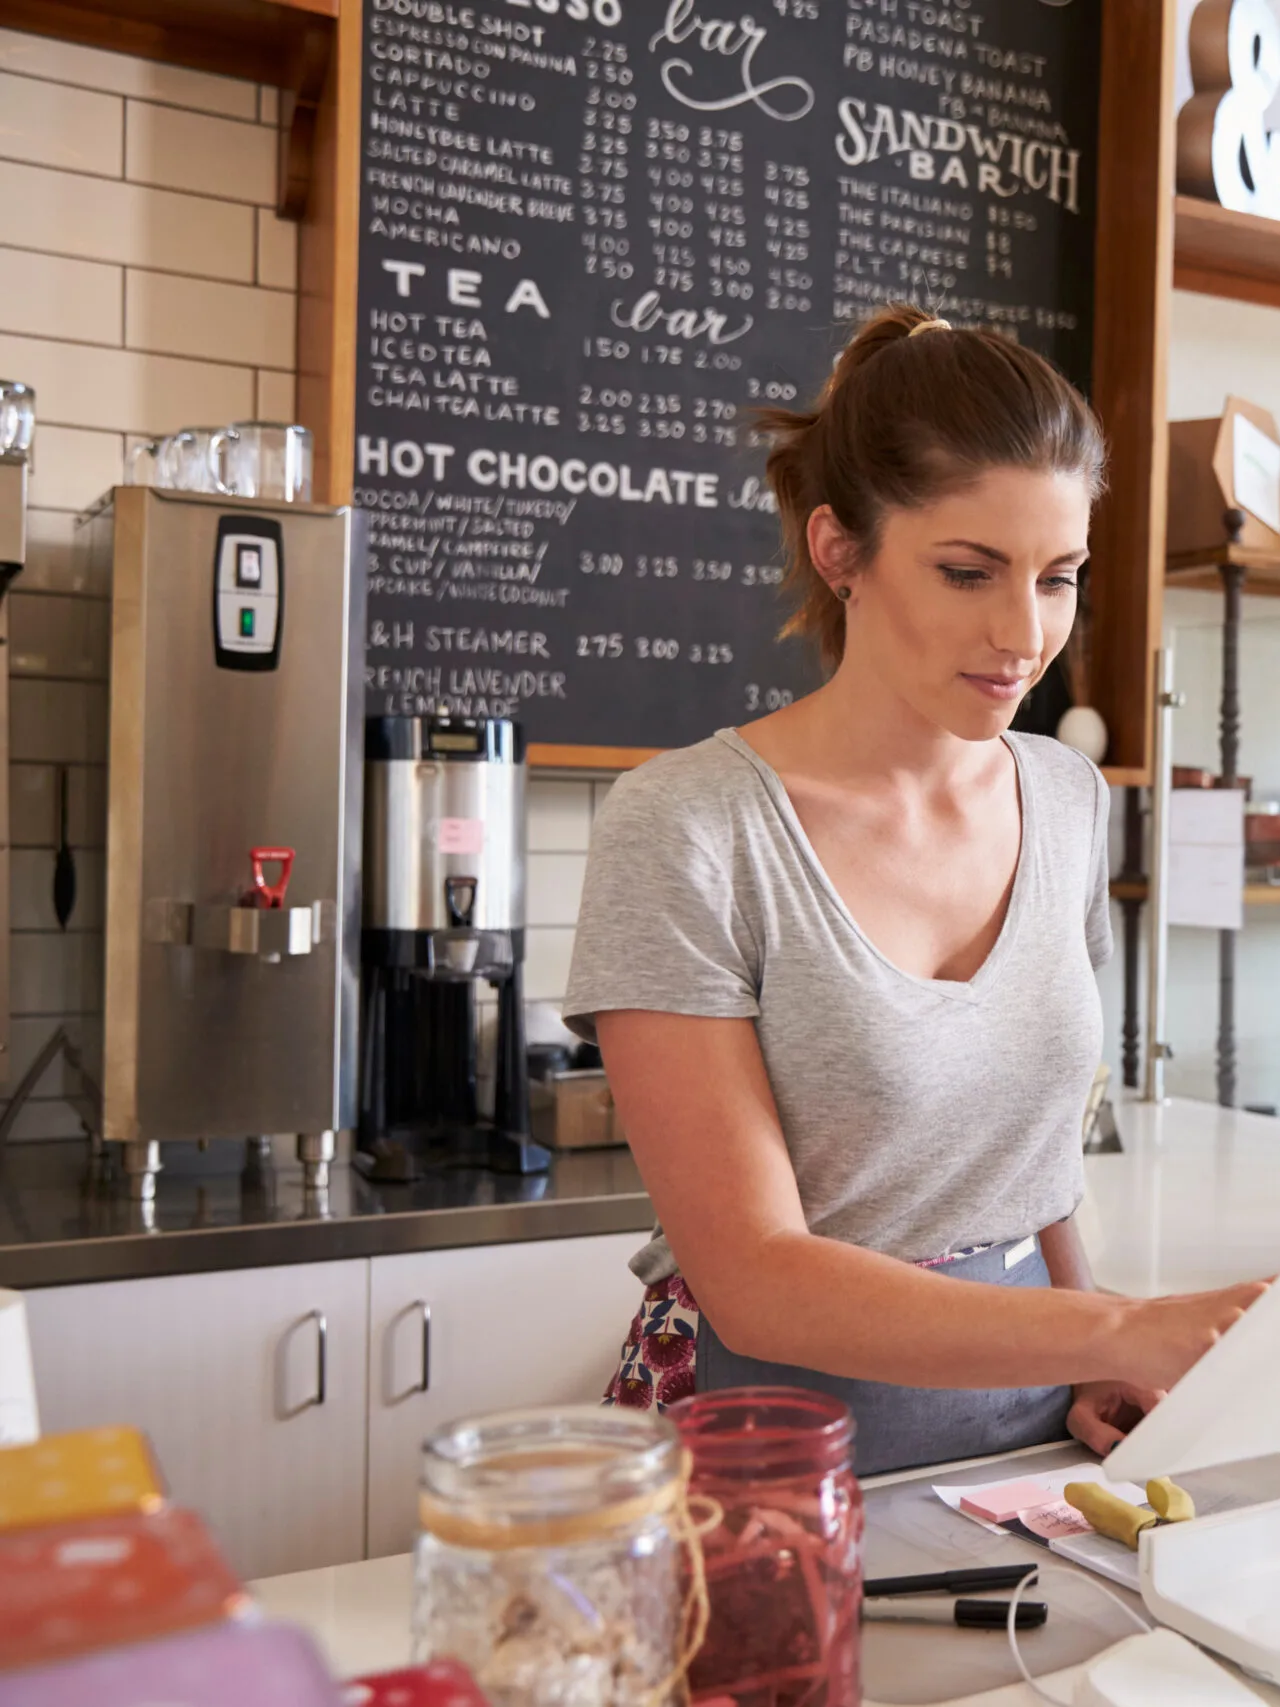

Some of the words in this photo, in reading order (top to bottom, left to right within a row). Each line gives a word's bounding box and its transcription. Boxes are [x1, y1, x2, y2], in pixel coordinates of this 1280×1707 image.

[369, 14, 469, 51] ESPRESSO
[478, 14, 546, 47] SHOT
[905, 2, 984, 37] TOAST
[369, 37, 490, 79] CORTADO
[846, 12, 968, 59] PASADENA
[973, 42, 1048, 78] TOAST
[369, 62, 536, 112] CAPPUCCINO
[843, 42, 875, 72] PB
[879, 53, 956, 93] HONEY
[960, 70, 1052, 114] BANANA
[372, 86, 460, 121] LATTE
[370, 109, 481, 152] HONEYBEE
[485, 136, 554, 166] LATTE
[834, 95, 1081, 215] SANDWICH
[366, 137, 438, 167] SALTED
[437, 152, 519, 185] CARAMEL
[520, 171, 573, 196] LATTE
[366, 166, 436, 196] FRENCH
[908, 150, 1020, 198] BAR
[371, 193, 460, 226] MOCHA
[837, 175, 878, 202] THE
[881, 186, 974, 221] ITALIANO
[369, 216, 522, 260] AMERICANO
[837, 202, 875, 227] THE
[879, 210, 971, 246] PARISIAN
[837, 228, 875, 253] THE
[879, 236, 968, 270] CAPRESE
[381, 259, 550, 319] TEA
[369, 307, 426, 335] HOT
[434, 314, 488, 342] TEA
[610, 290, 754, 345] bar
[369, 335, 438, 363] ICED
[440, 343, 492, 368] TEA
[370, 361, 427, 387] TEA
[432, 368, 520, 397] LATTE
[367, 385, 431, 412] CHAI
[433, 394, 481, 419] TEA
[484, 402, 561, 427] LATTE
[358, 435, 455, 482] HOT
[467, 448, 720, 508] CHOCOLATE
[727, 475, 779, 514] ba
[425, 625, 551, 659] STEAMER
[364, 664, 442, 696] RENCH
[450, 665, 567, 699] LAVENDER
[385, 692, 520, 719] LEMONADE
